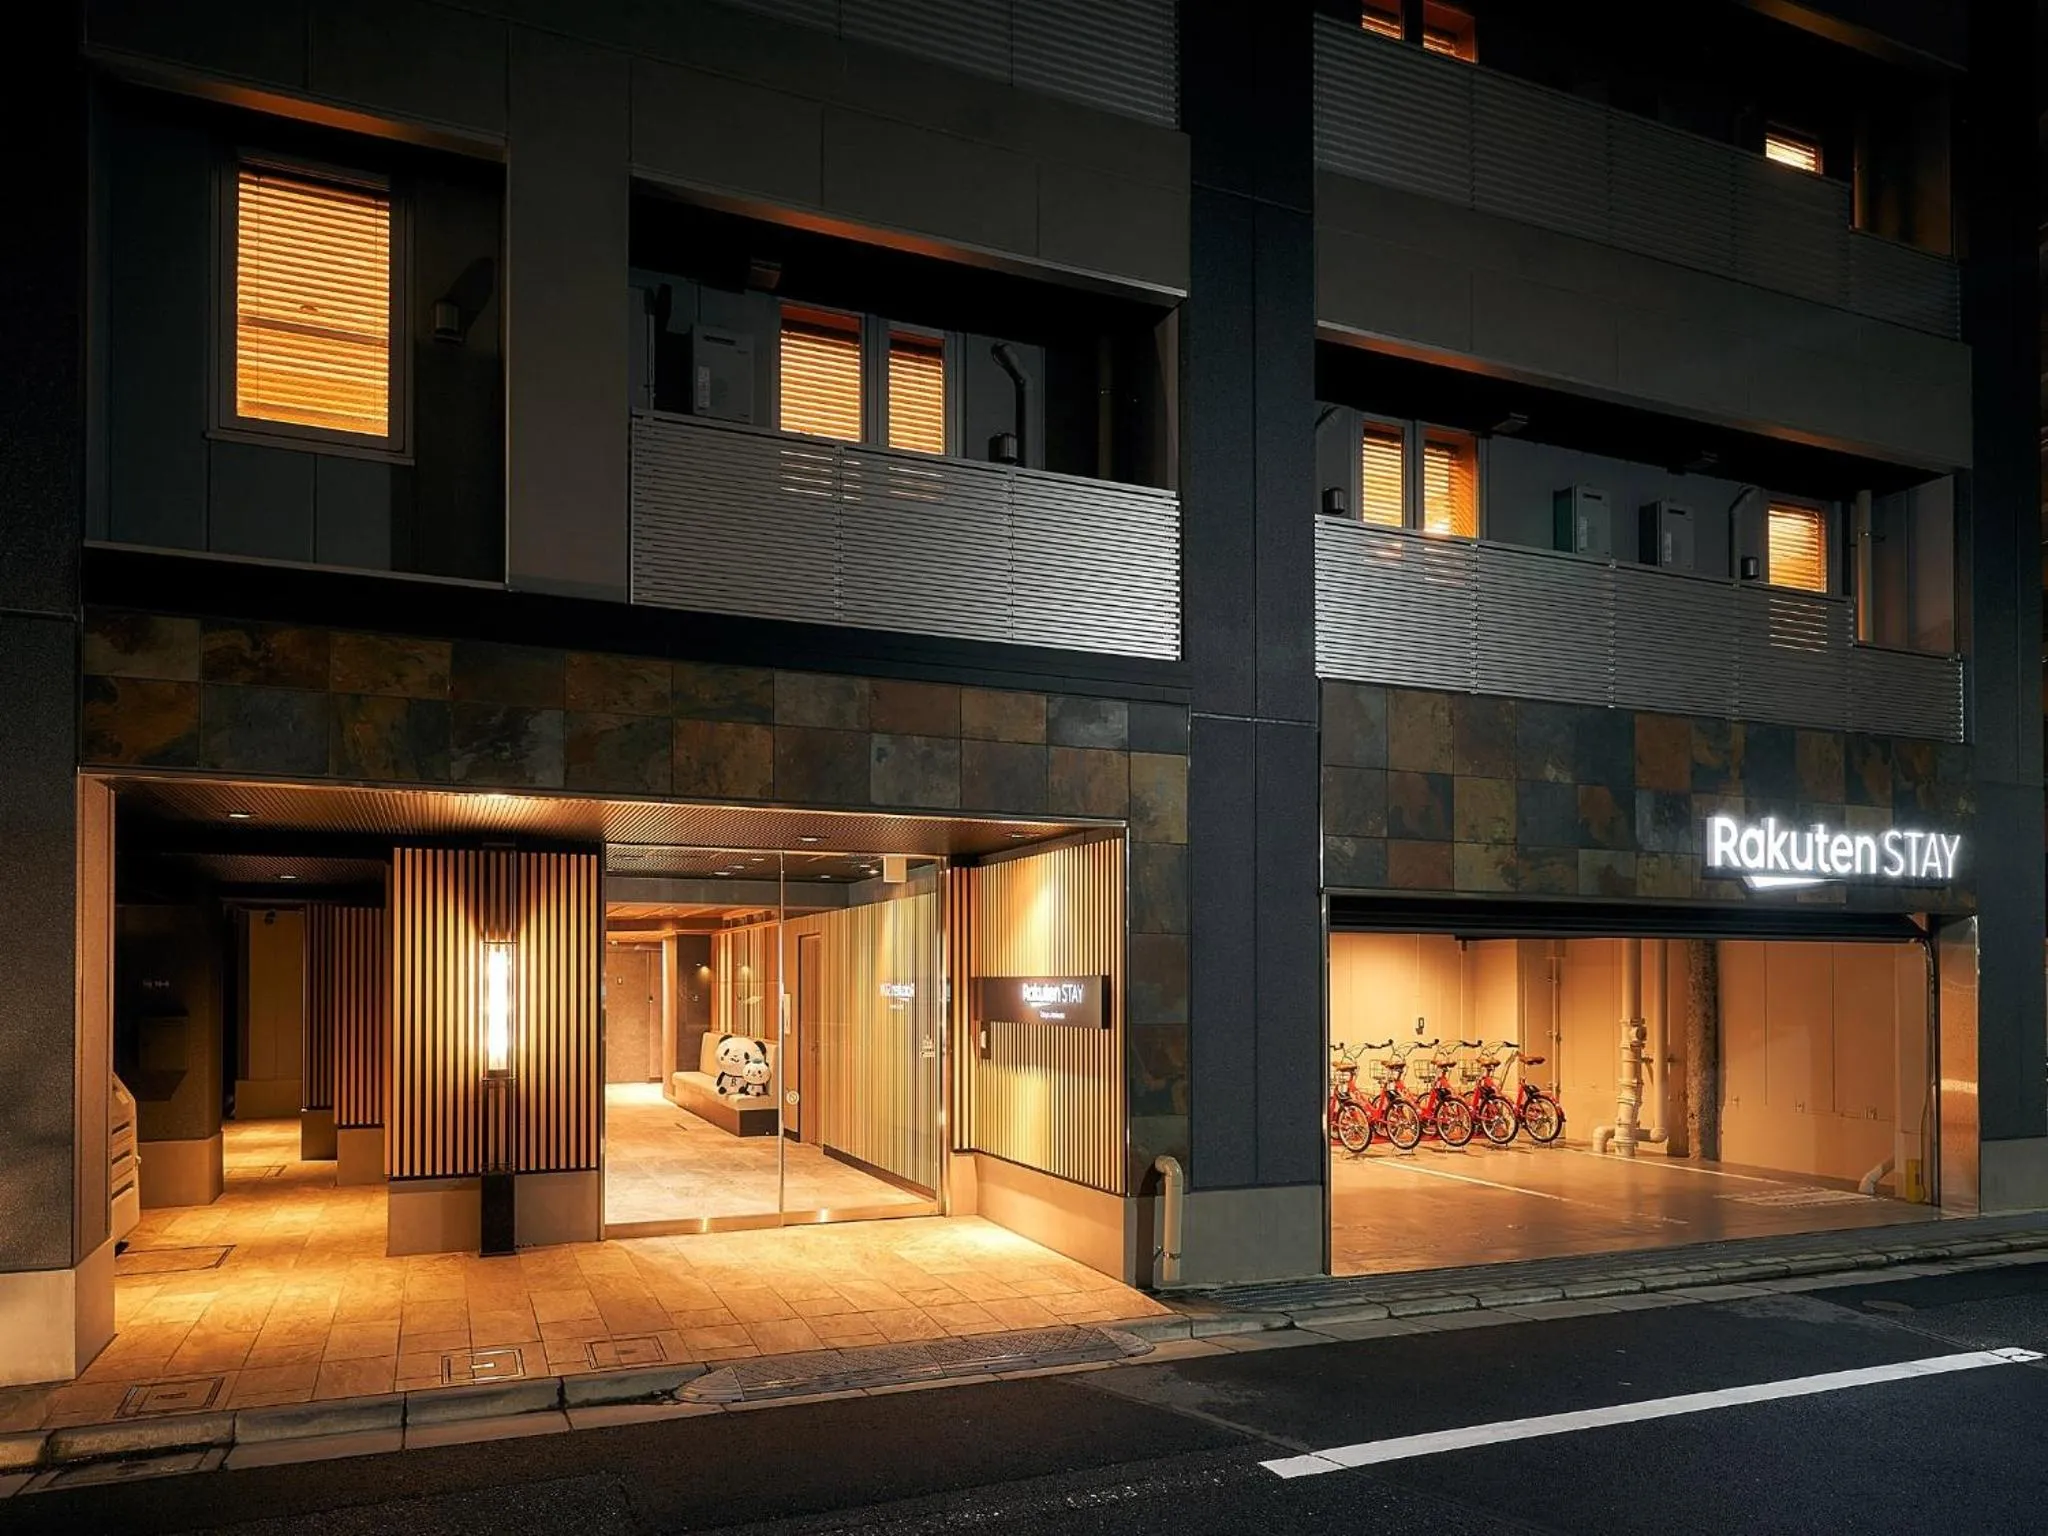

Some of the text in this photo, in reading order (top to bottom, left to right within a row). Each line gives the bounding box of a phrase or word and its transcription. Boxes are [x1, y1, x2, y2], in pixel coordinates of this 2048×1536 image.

[1708, 816, 1960, 878] Rakuten STAY
[1062, 984, 1084, 1004] STAY
